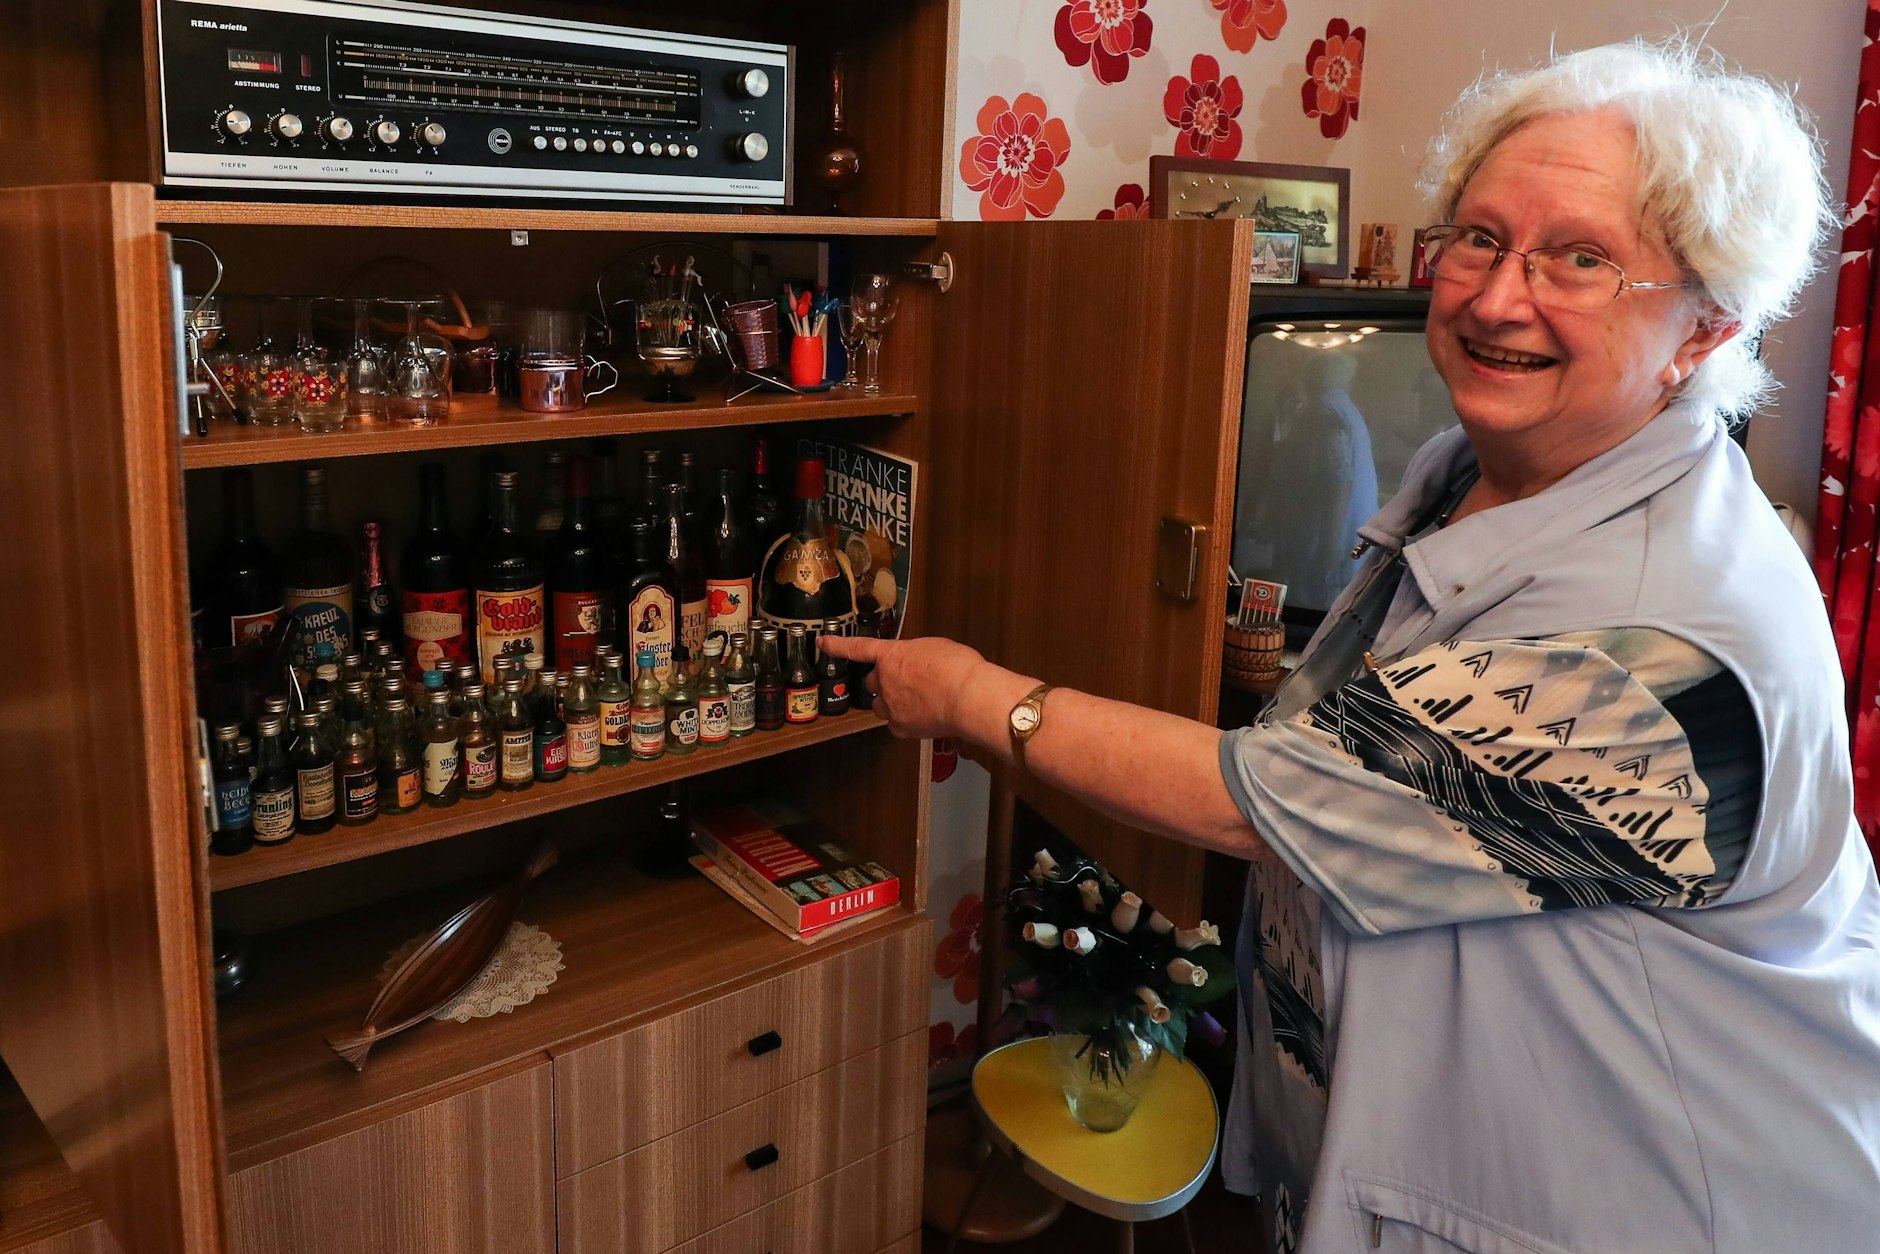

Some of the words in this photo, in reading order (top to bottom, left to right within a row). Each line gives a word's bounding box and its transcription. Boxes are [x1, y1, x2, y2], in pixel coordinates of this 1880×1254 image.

[191, 19, 218, 29] REMA
[219, 23, 248, 32] arietta
[234, 80, 280, 89] ABSTIMMUNG
[295, 84, 321, 92] STEREO
[825, 468, 907, 522] TRÄNKE
[825, 492, 907, 547] TRÄNKE
[783, 548, 829, 561] GAMZA
[304, 606, 340, 629] KREUZ
[315, 626, 337, 644] DES
[829, 889, 875, 916] BERLIN
